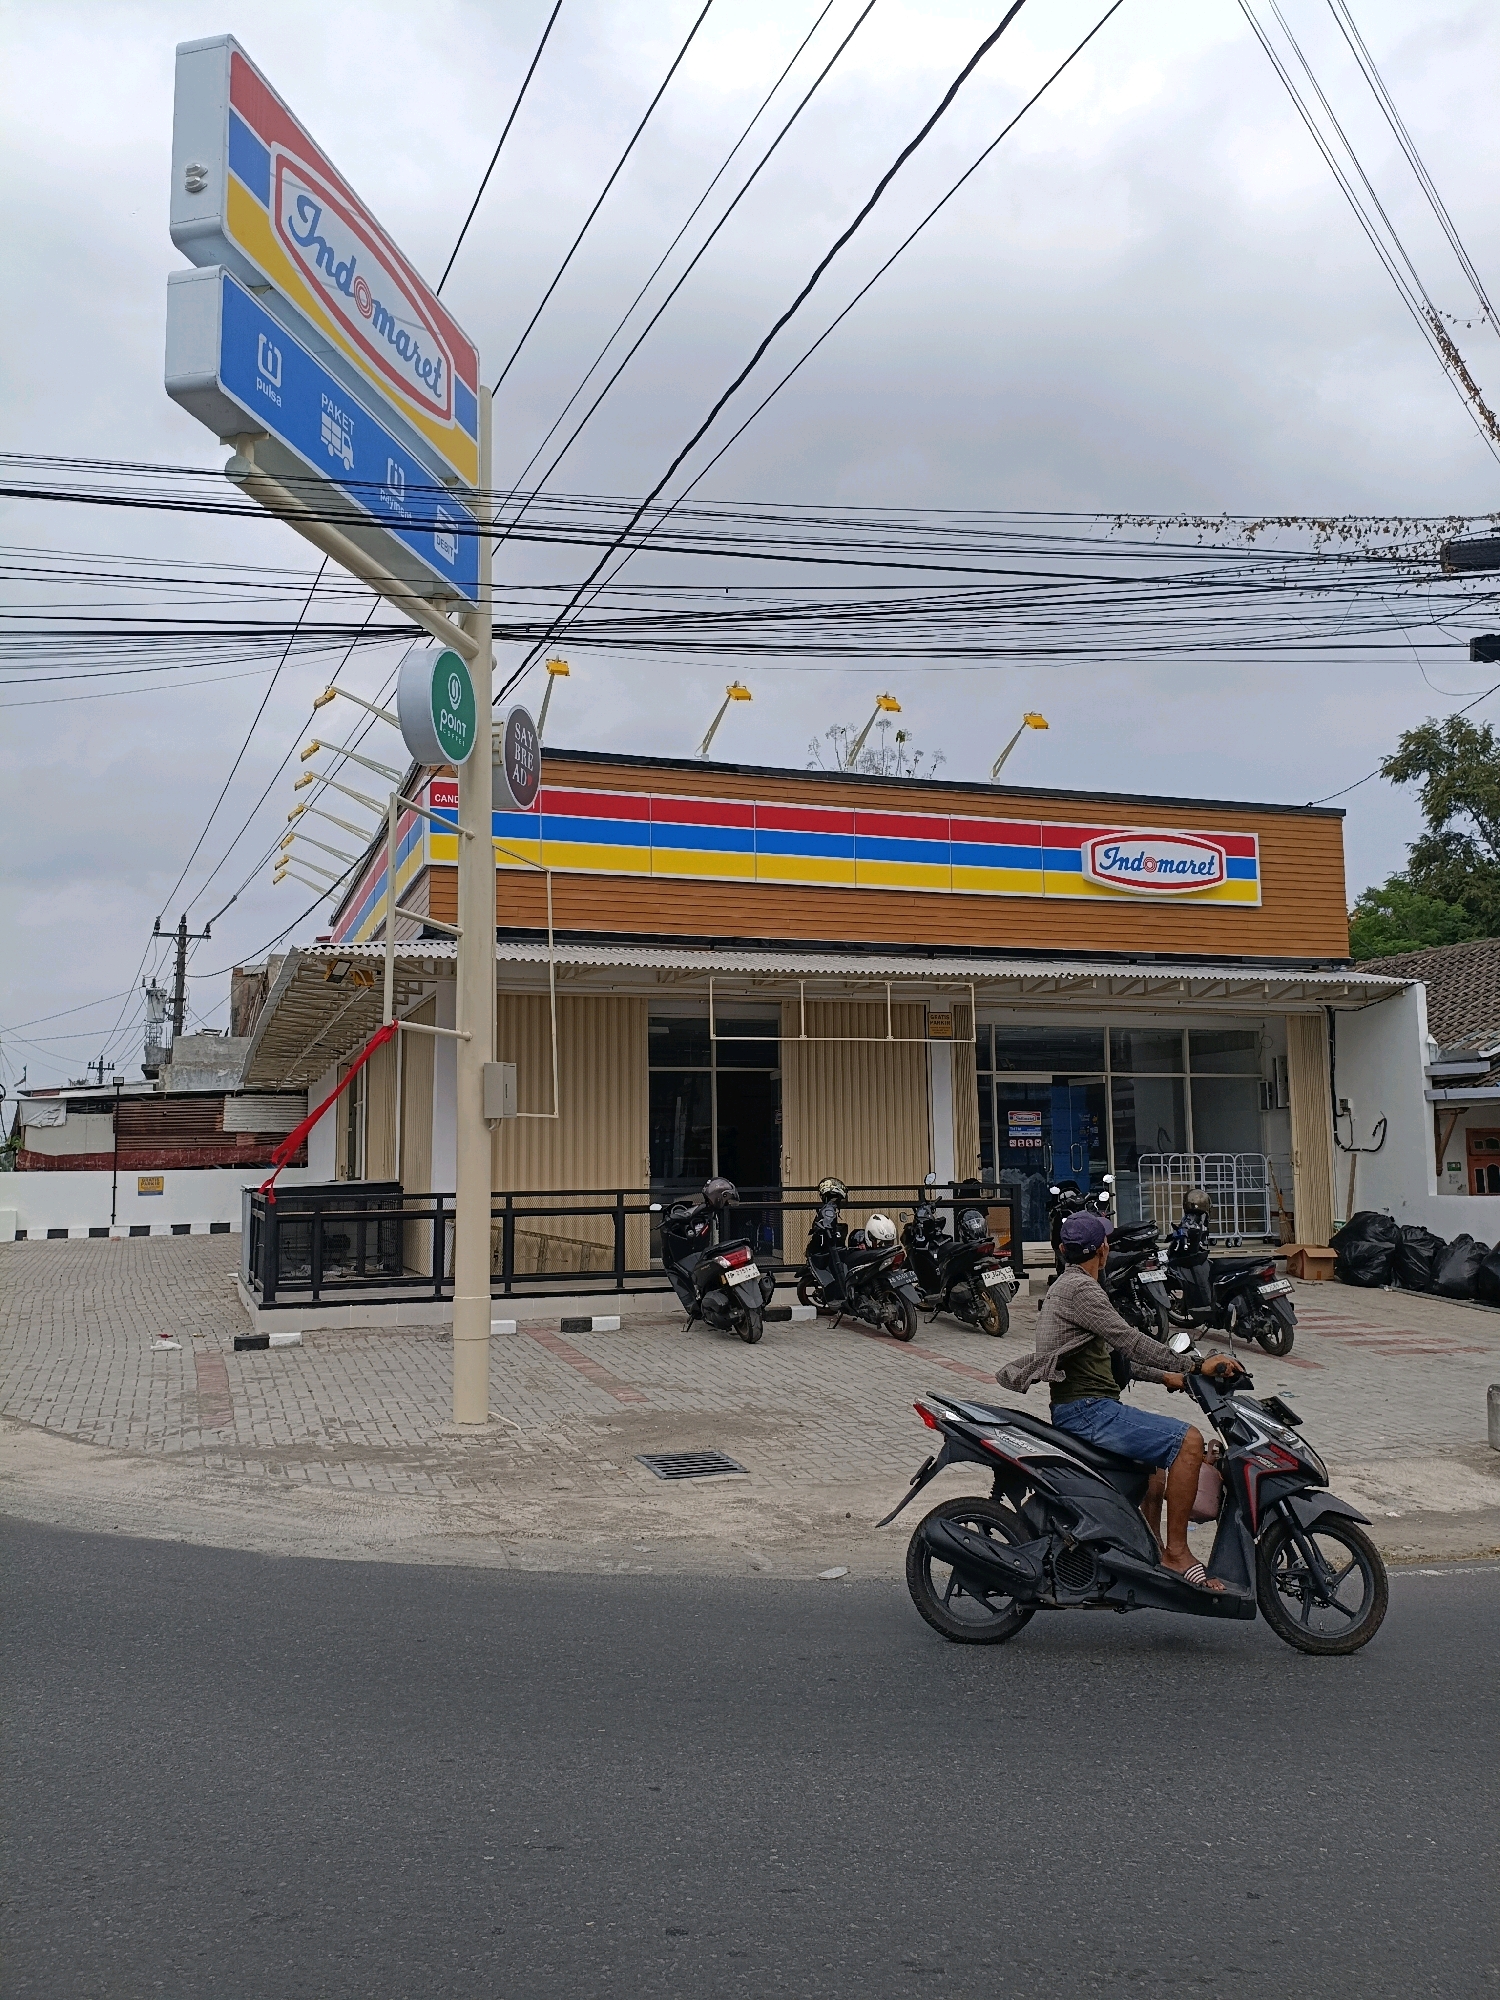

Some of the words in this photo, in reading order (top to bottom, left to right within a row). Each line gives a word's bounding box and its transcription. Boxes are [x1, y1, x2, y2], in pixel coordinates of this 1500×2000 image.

[288, 194, 442, 398] Indomaret
[256, 376, 282, 407] pulsa
[321, 393, 355, 435] PAKET
[436, 534, 454, 557] DEBIT
[514, 722, 534, 749] SAY
[514, 742, 534, 771] BRE
[512, 764, 527, 787] AD
[1099, 846, 1215, 876] Indomaret
